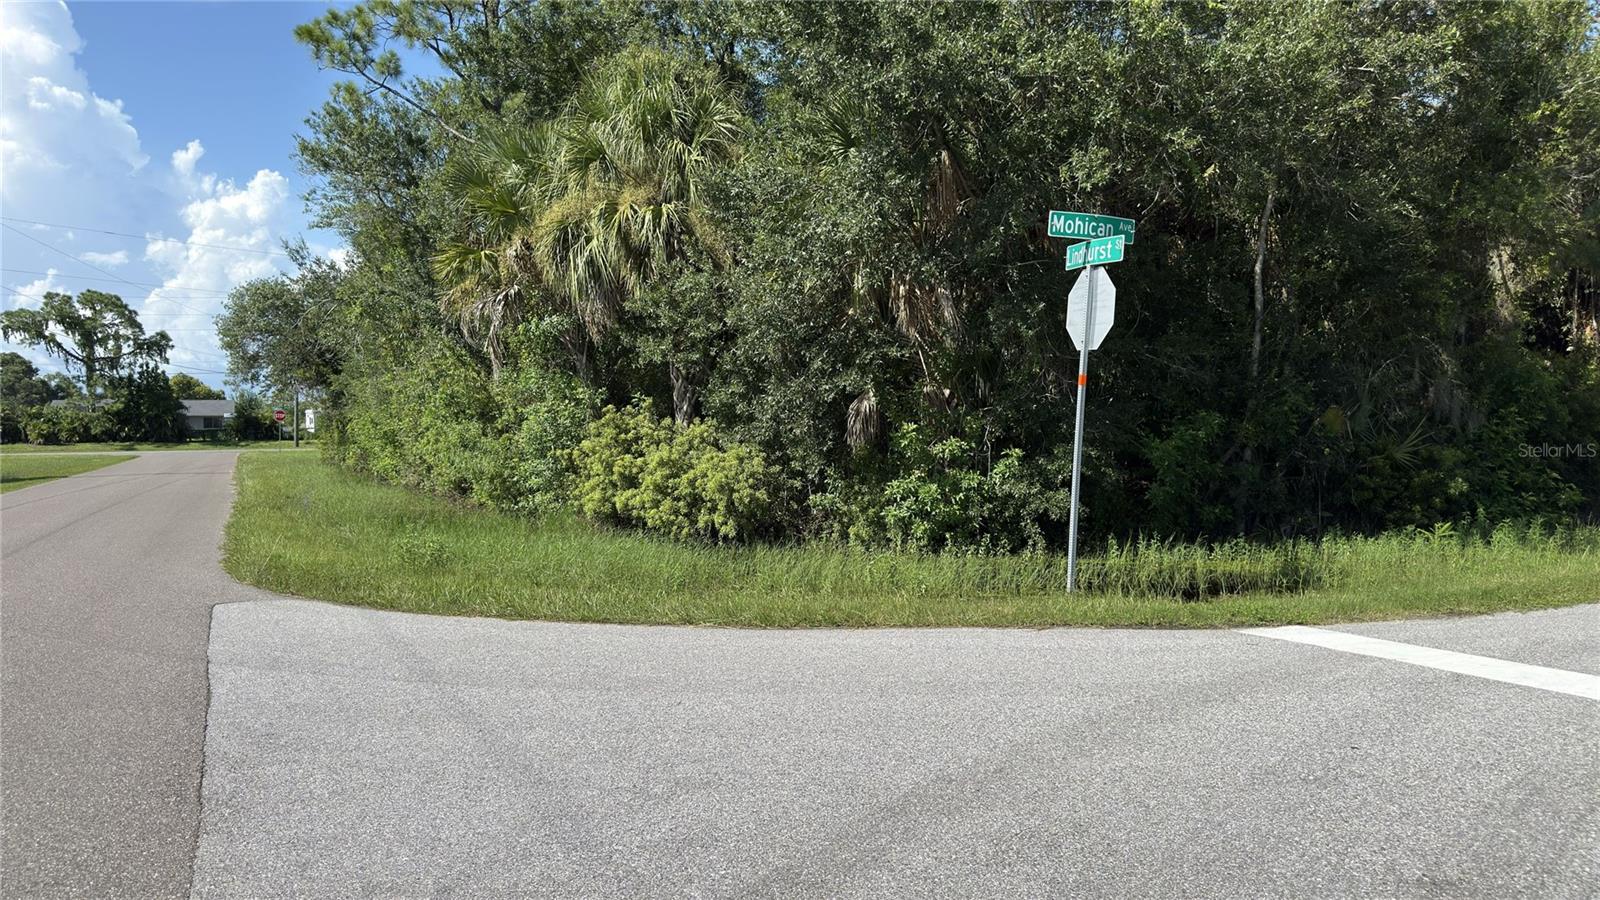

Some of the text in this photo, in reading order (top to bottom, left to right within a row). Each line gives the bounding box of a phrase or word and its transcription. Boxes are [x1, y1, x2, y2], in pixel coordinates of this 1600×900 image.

[1053, 215, 1114, 237] Mohican
[1067, 239, 1122, 265] Lindhurst St
